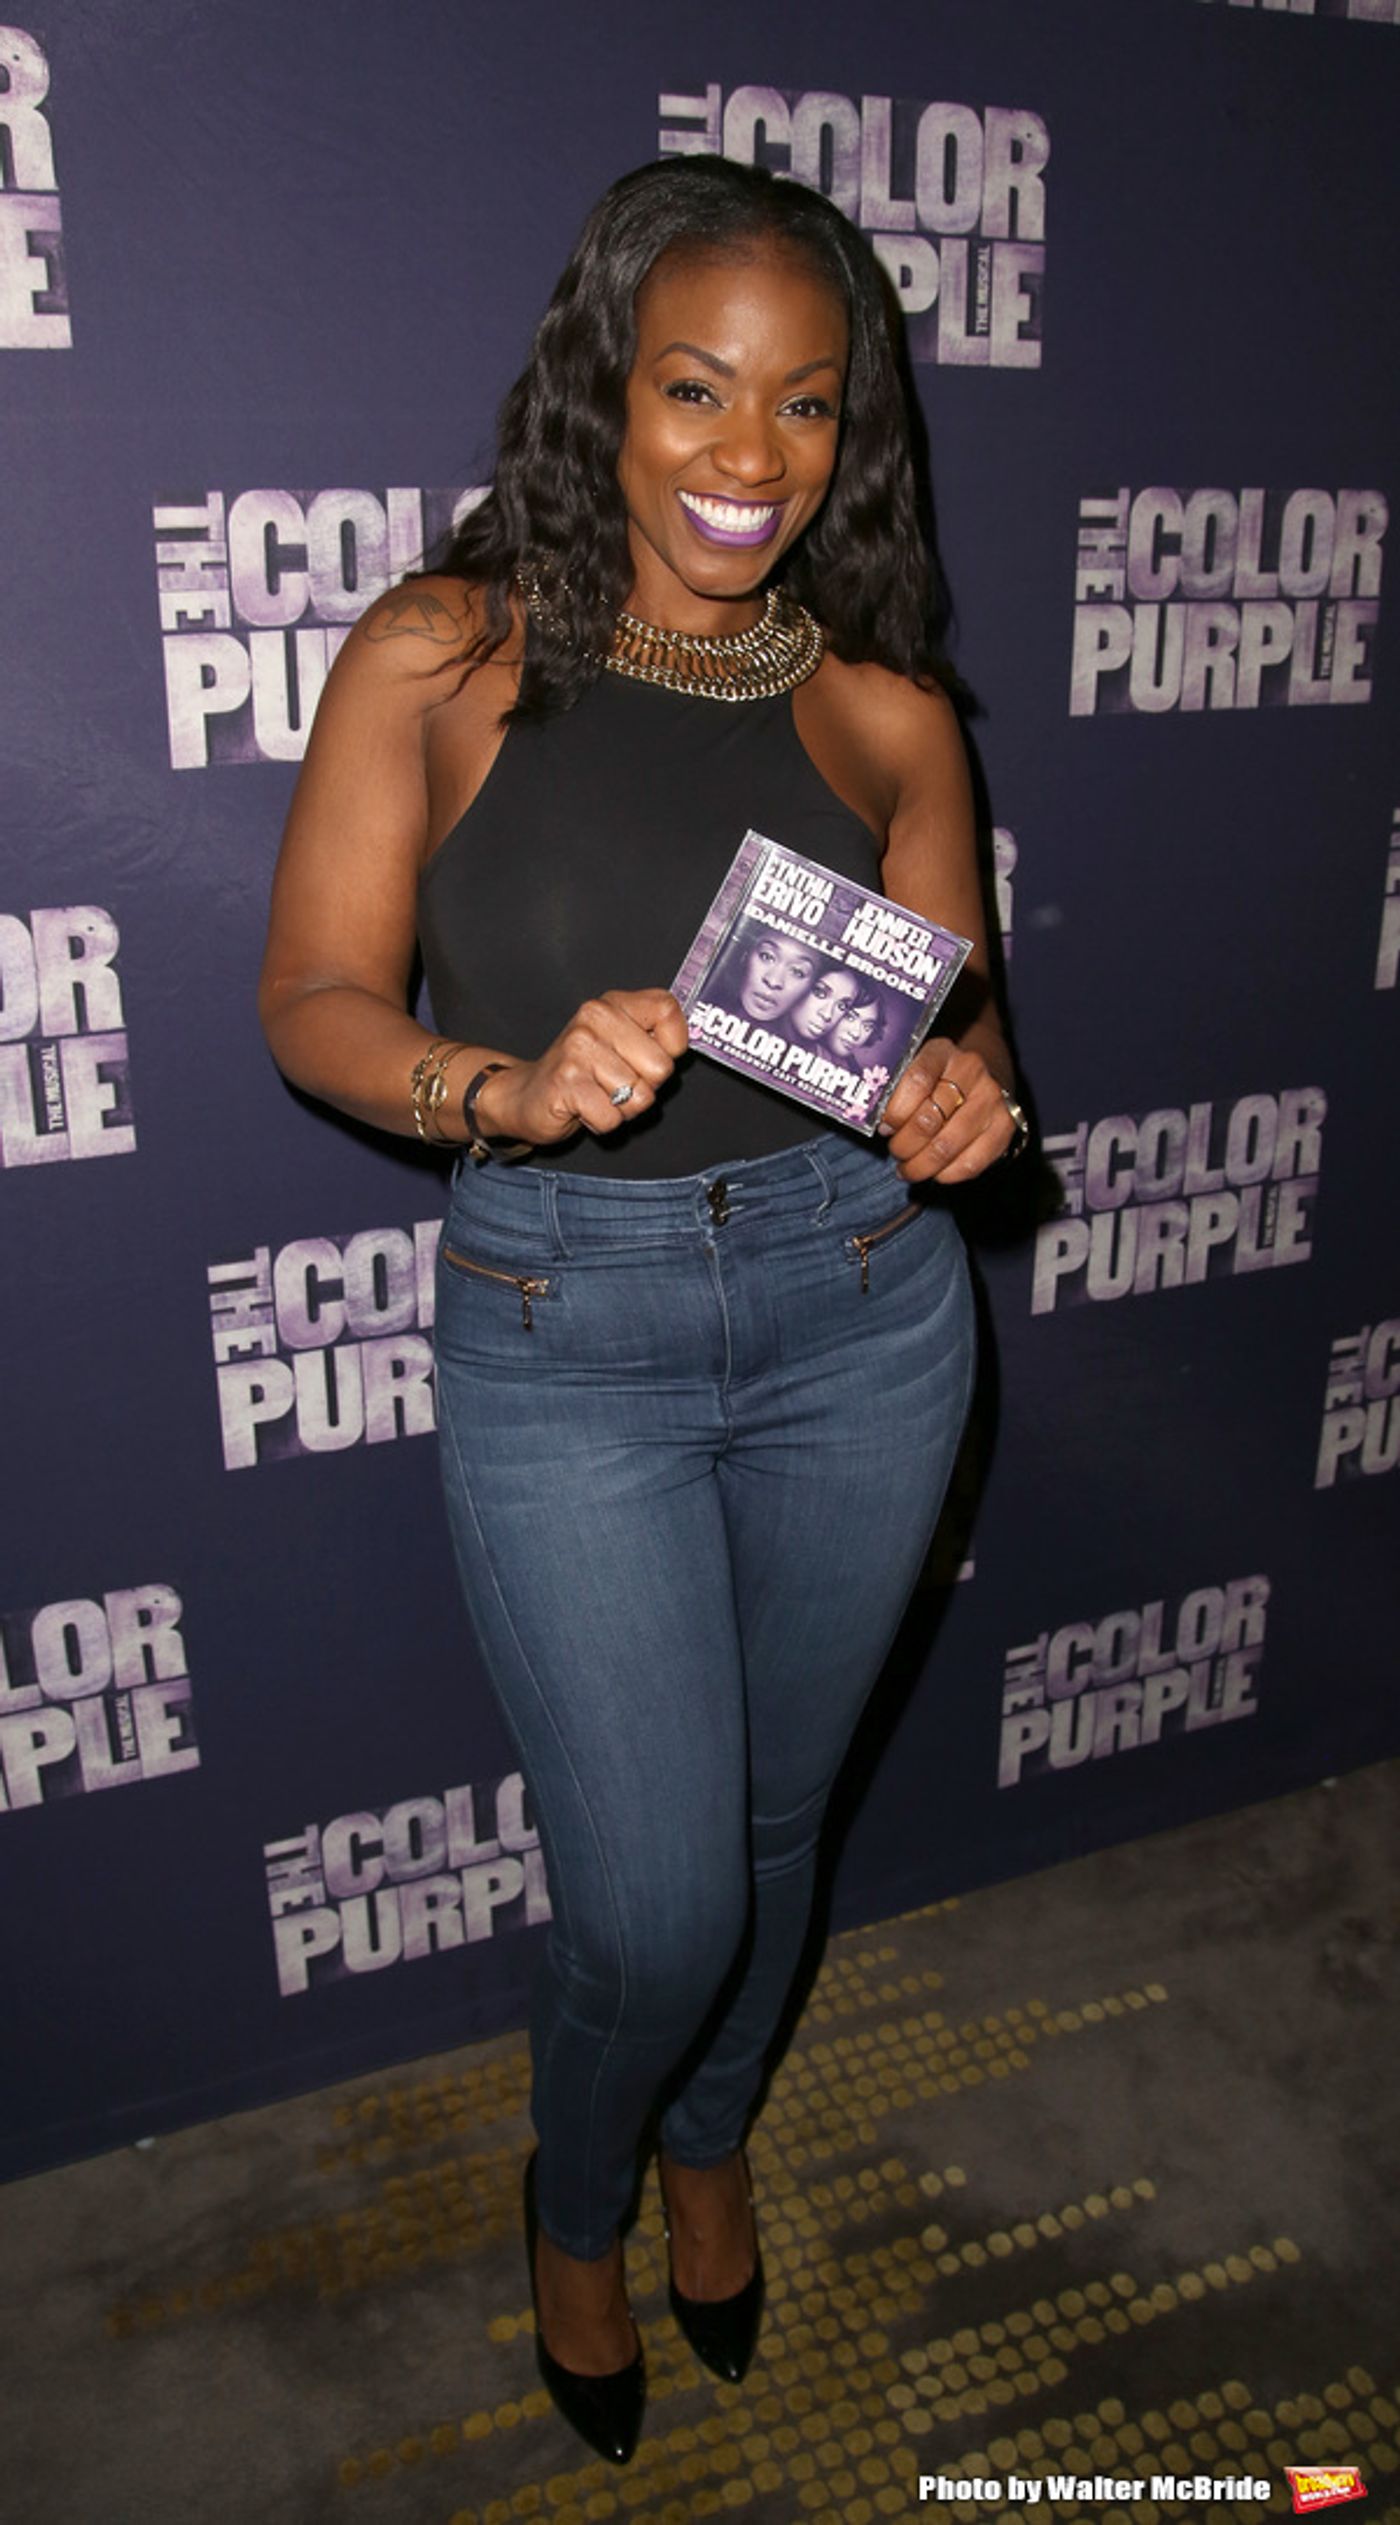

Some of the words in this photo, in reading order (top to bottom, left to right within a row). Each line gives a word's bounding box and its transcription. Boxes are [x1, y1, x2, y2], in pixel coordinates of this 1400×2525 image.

[872, 233, 1046, 368] PLE
[153, 491, 231, 630] THE
[228, 487, 492, 626] COL
[1076, 488, 1130, 601] THE
[1127, 487, 1389, 600] COLOR
[1069, 600, 1380, 717] PURPLE
[743, 902, 846, 962] DANIELLE
[845, 952, 928, 1001] BROOKS
[752, 875, 826, 927] ERIVO
[841, 917, 943, 986] HUDSON
[854, 901, 933, 951] JENNIFER
[702, 1005, 788, 1067] COLOR
[780, 1044, 872, 1109] PURPLE
[1085, 1086, 1328, 1210] COLOR
[207, 1246, 277, 1363] THE
[273, 1218, 444, 1349] COL
[1030, 1176, 1319, 1315] PURPLE
[216, 1334, 438, 1471] PUR
[1325, 1324, 1371, 1412] THE
[1002, 1632, 1049, 1716] THE
[1045, 1574, 1272, 1700] COLOR
[0, 1677, 201, 1813] PLE
[998, 1646, 1263, 1789] PURPLE
[263, 1823, 326, 1917] THE
[322, 1771, 541, 1898] COLO
[273, 1848, 554, 1997] PURPL
